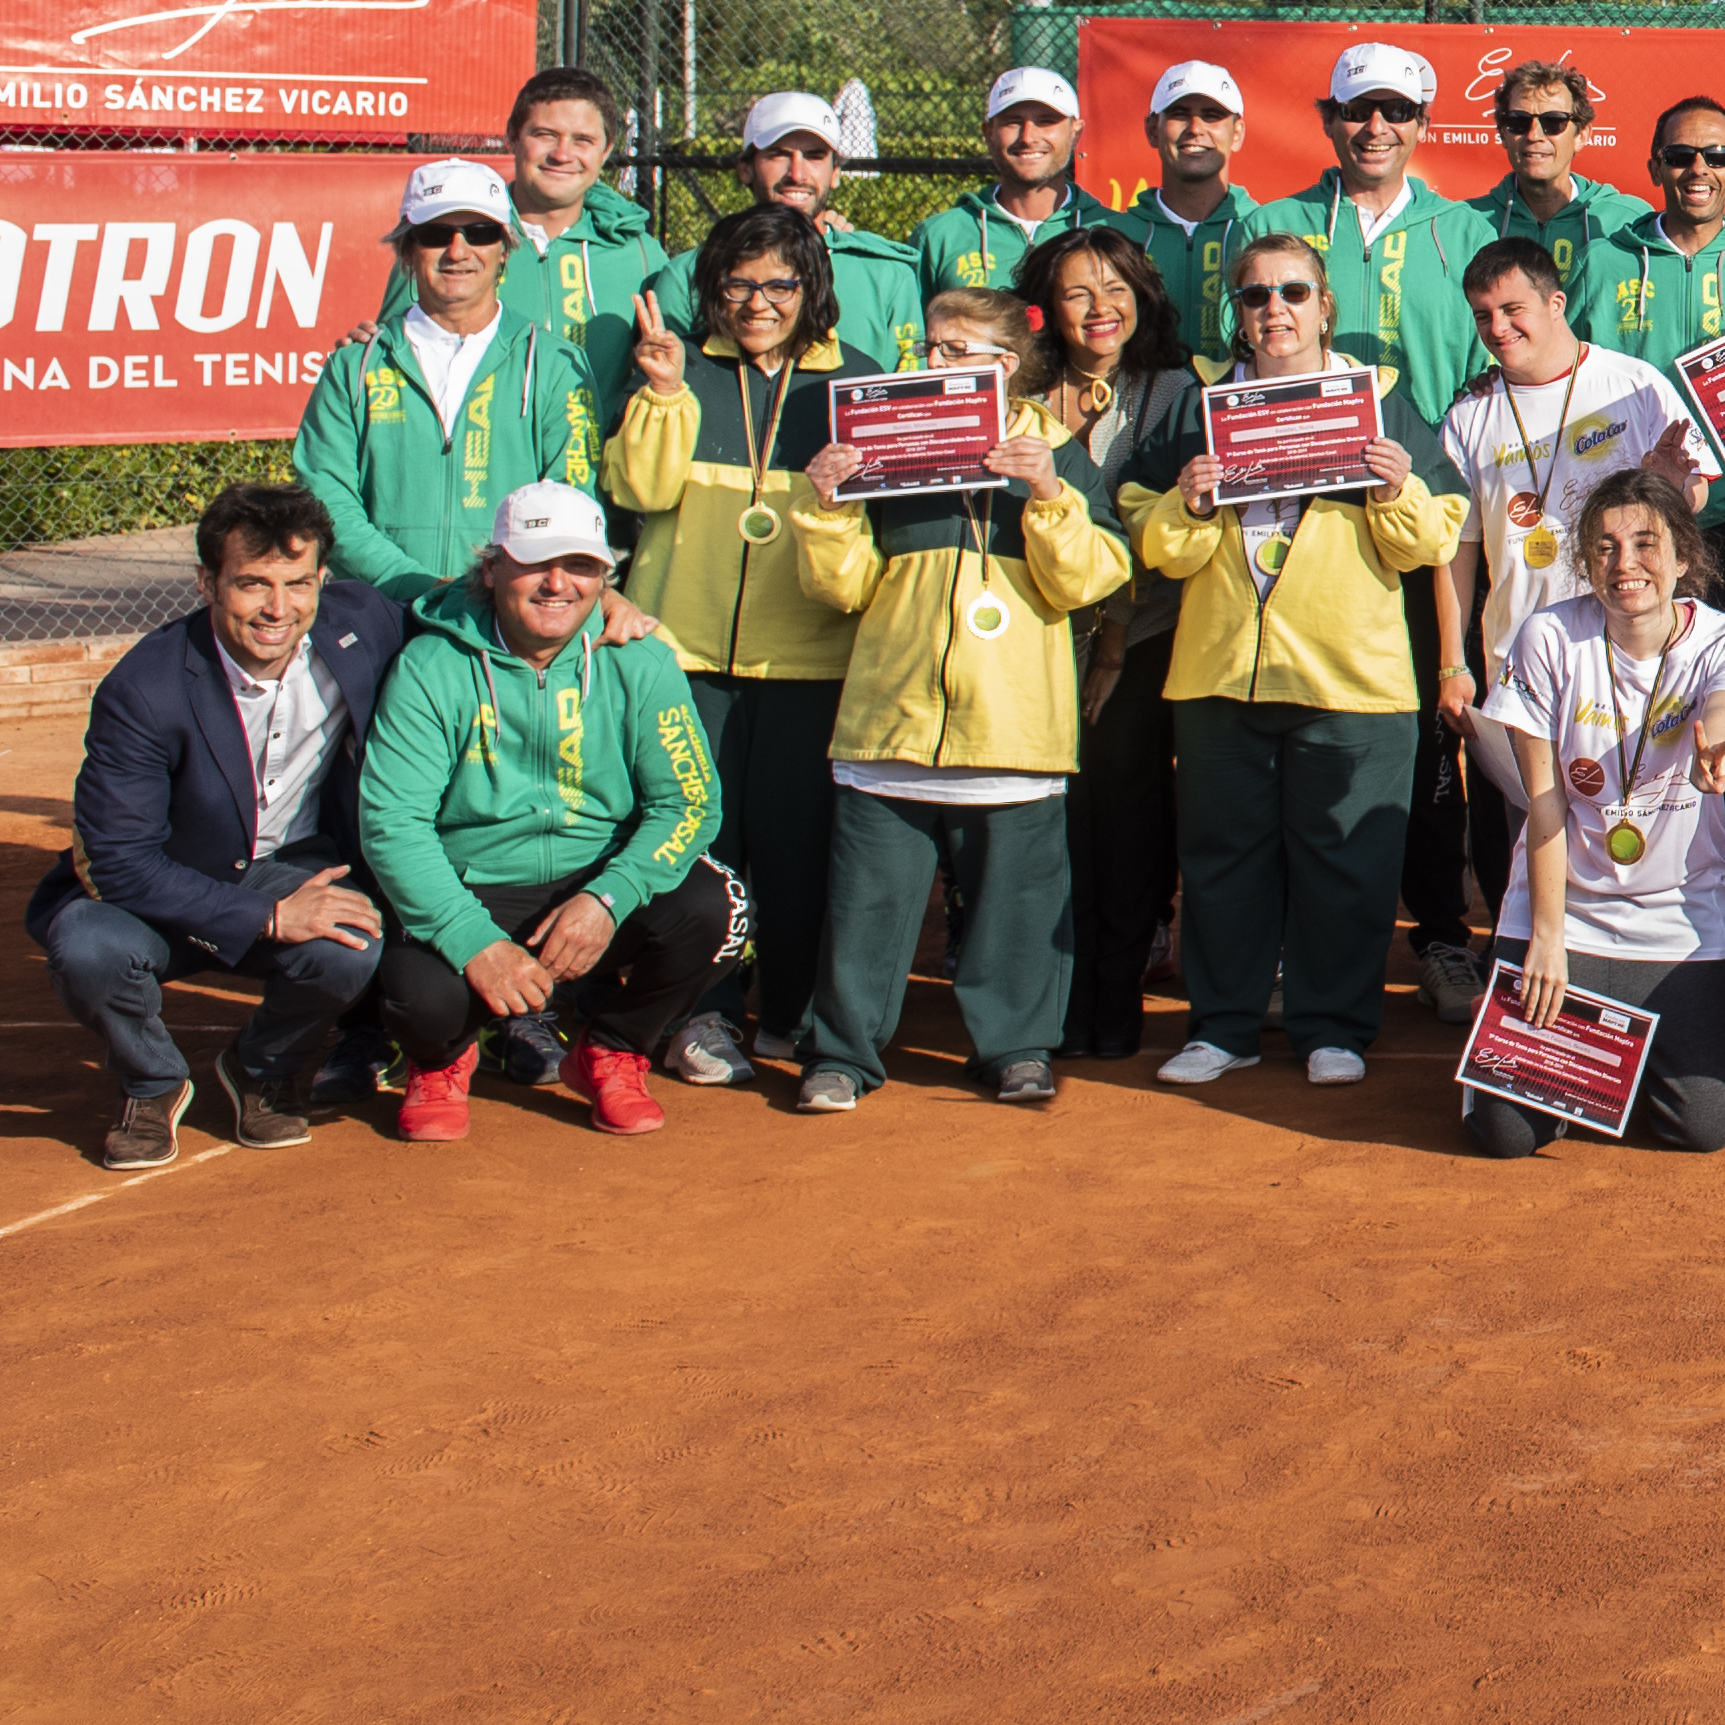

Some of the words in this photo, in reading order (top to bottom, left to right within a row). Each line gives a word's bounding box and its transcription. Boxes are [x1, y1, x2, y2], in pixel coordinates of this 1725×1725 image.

[104, 78, 264, 114] SÁNCHEZ
[279, 87, 408, 116] VICARIO
[1443, 133, 1489, 145] EMILIO
[1583, 134, 1616, 147] ARIO
[88, 355, 181, 388] DEL
[194, 351, 331, 386] TENIS
[463, 373, 494, 508] HEA
